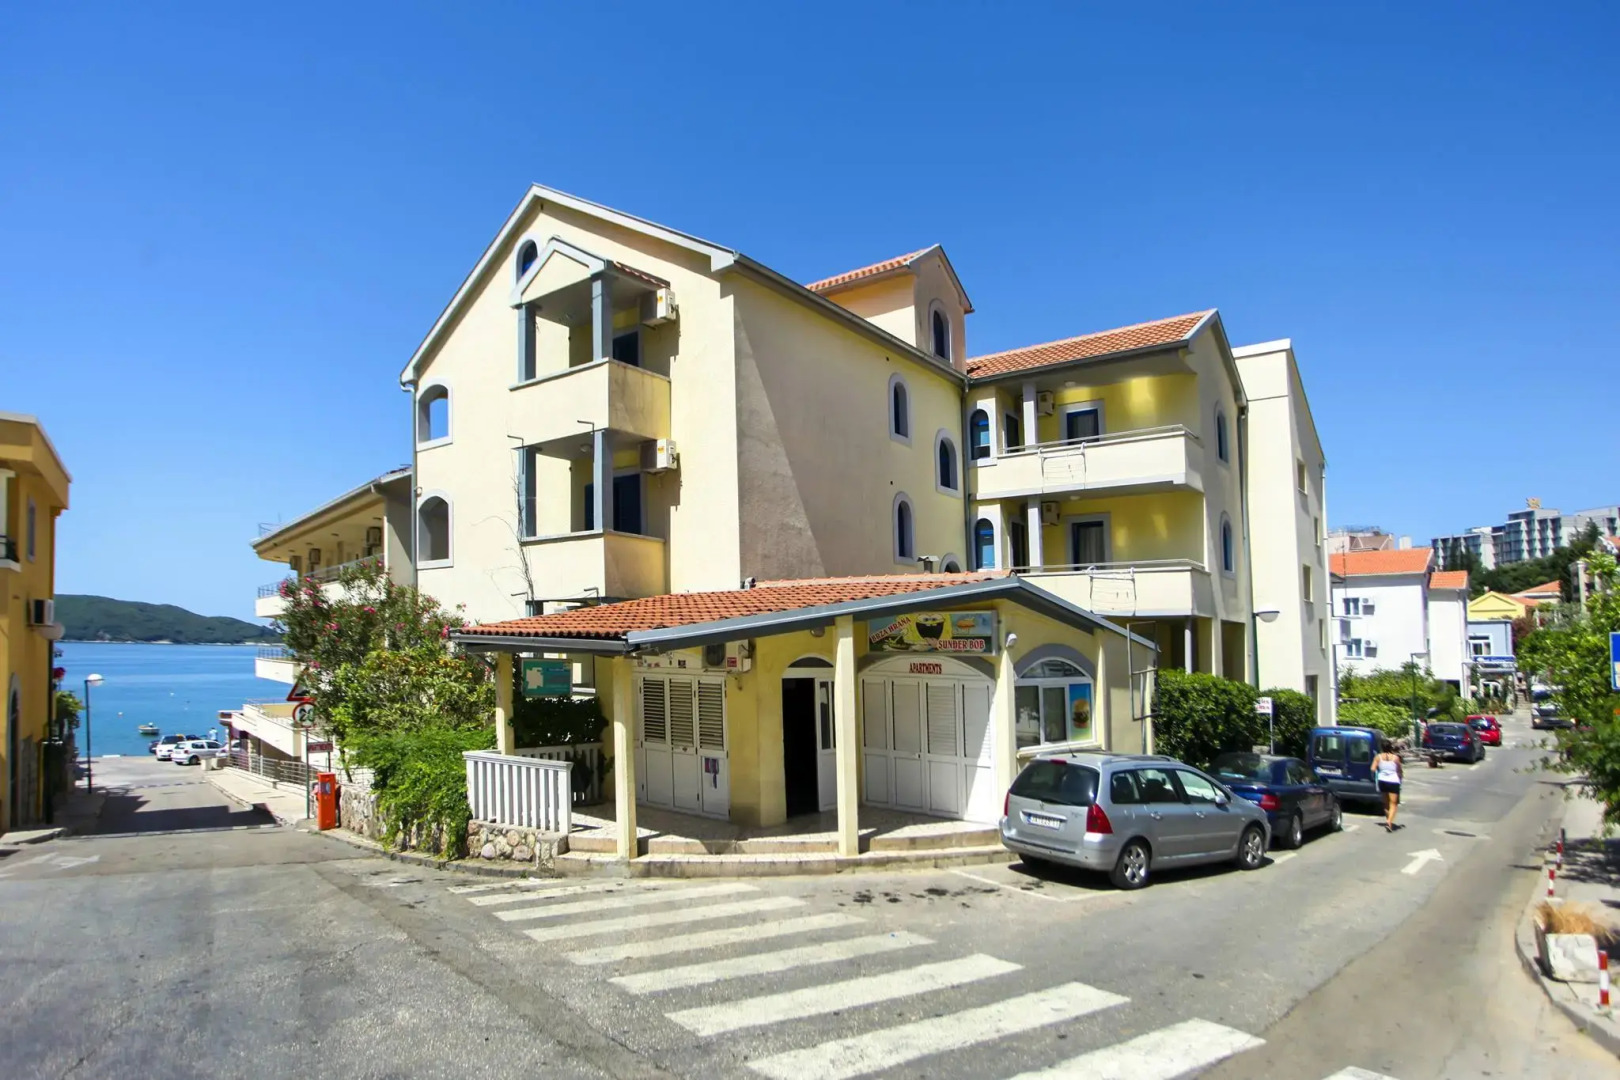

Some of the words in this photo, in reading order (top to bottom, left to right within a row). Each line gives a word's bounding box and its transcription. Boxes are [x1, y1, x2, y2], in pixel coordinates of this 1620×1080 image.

[888, 617, 911, 632] HRANA
[938, 639, 968, 649] SUNDER
[969, 639, 985, 649] BOB
[909, 662, 942, 674] APARTMENTS
